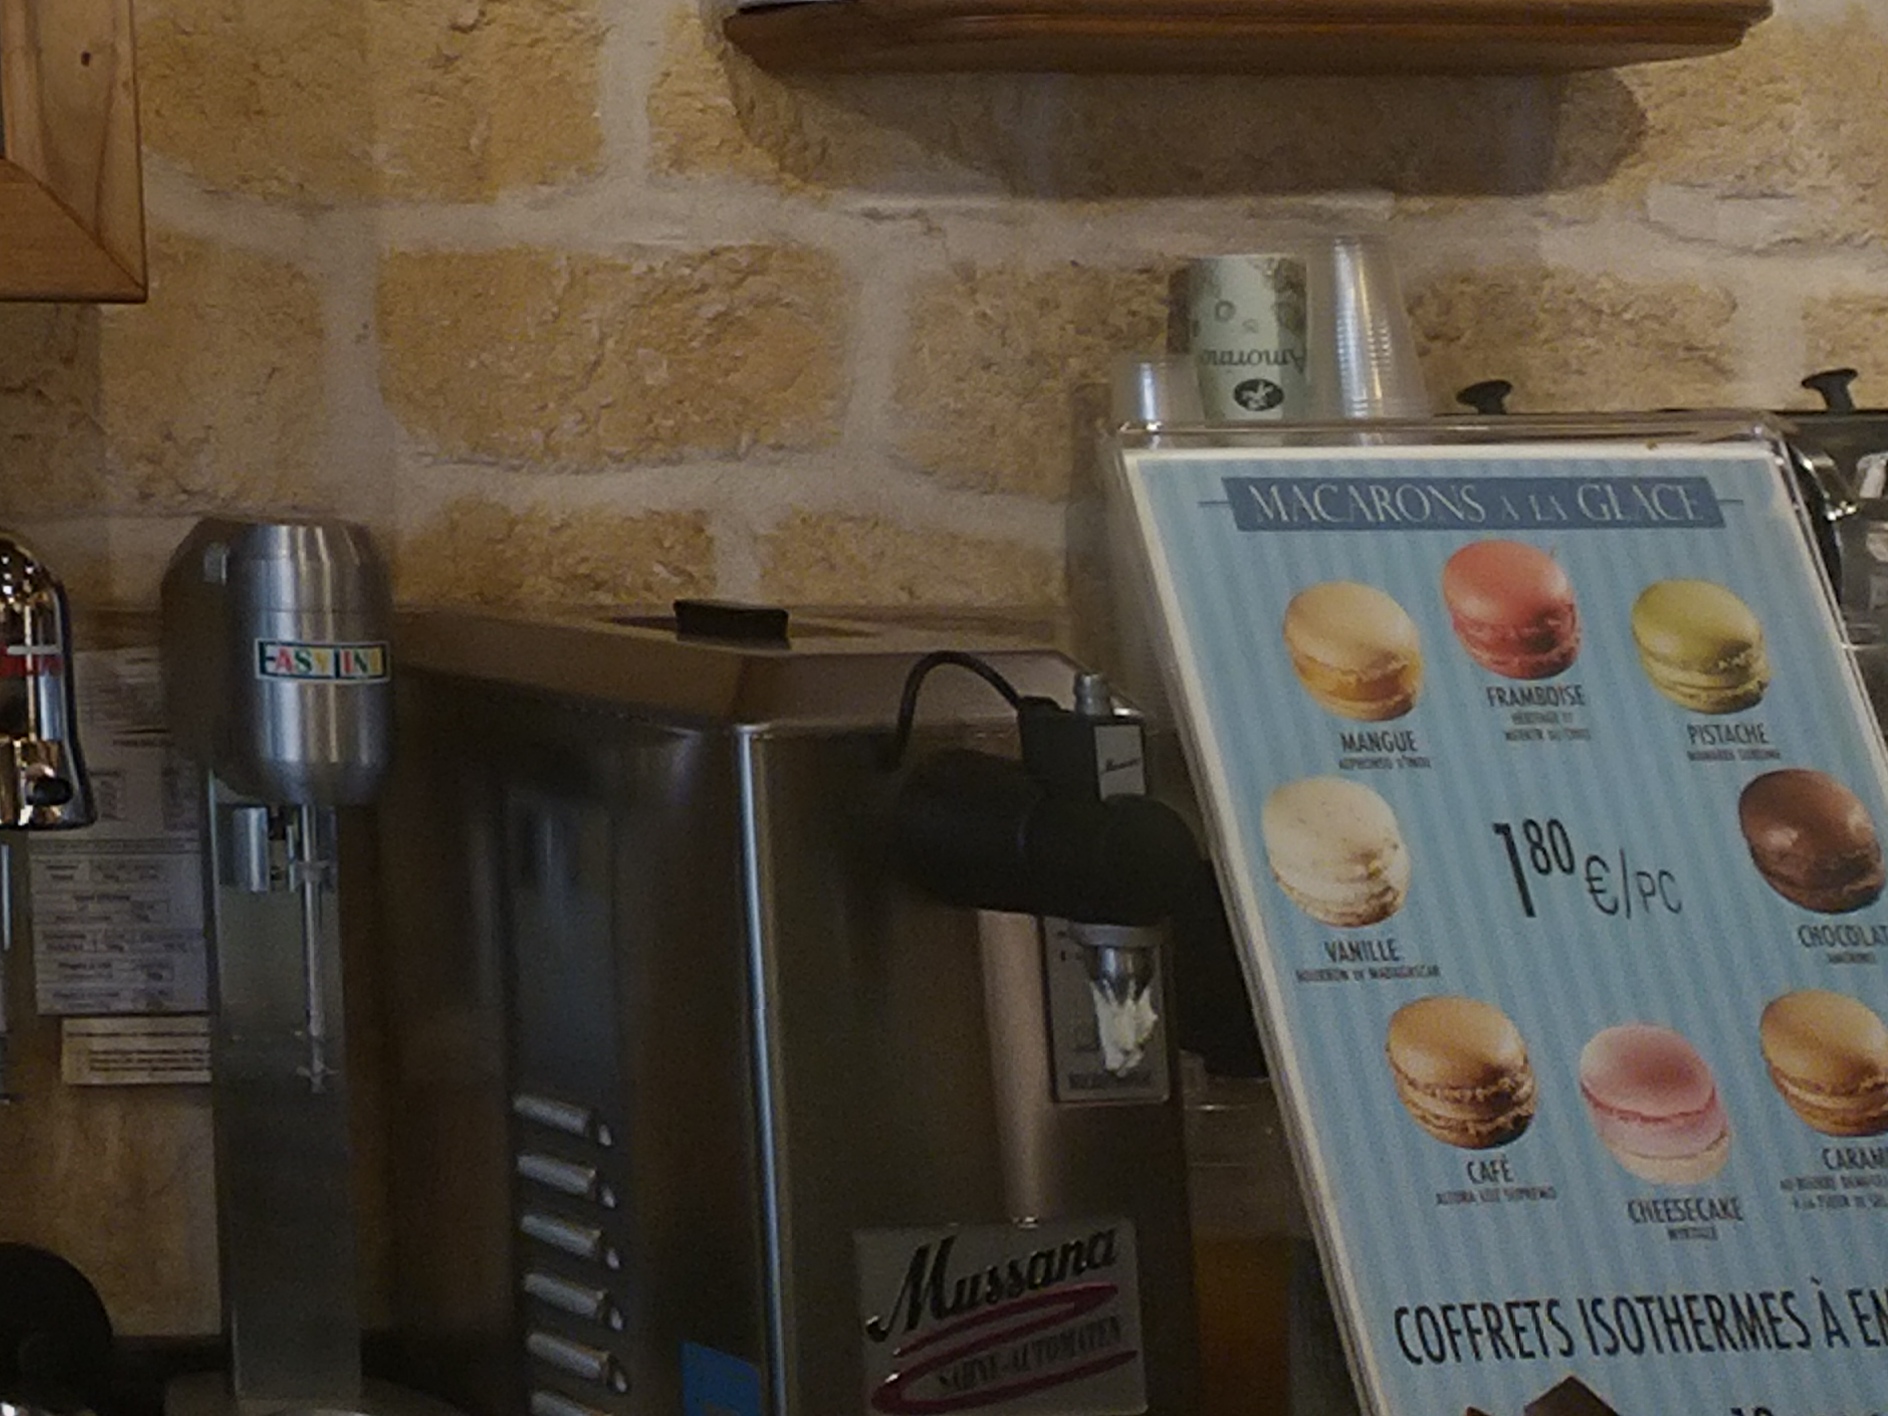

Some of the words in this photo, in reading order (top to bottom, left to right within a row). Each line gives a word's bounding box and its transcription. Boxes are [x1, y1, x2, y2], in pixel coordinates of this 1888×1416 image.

[1249, 484, 1486, 523] MACARONS
[1576, 483, 1704, 522] GLACE
[1485, 684, 1587, 707] FRAMBOISE
[1340, 730, 1417, 752] MANGUE
[1686, 723, 1770, 746] PISTACHE
[1324, 938, 1401, 964] VANILLE
[1627, 1197, 1744, 1225] CHEESECAKE
[865, 1228, 1118, 1343] Mussana
[1393, 1296, 1576, 1366] COFFRETS
[1578, 1288, 1814, 1358] ISOTHERMES
[1810, 1276, 1851, 1348] À
